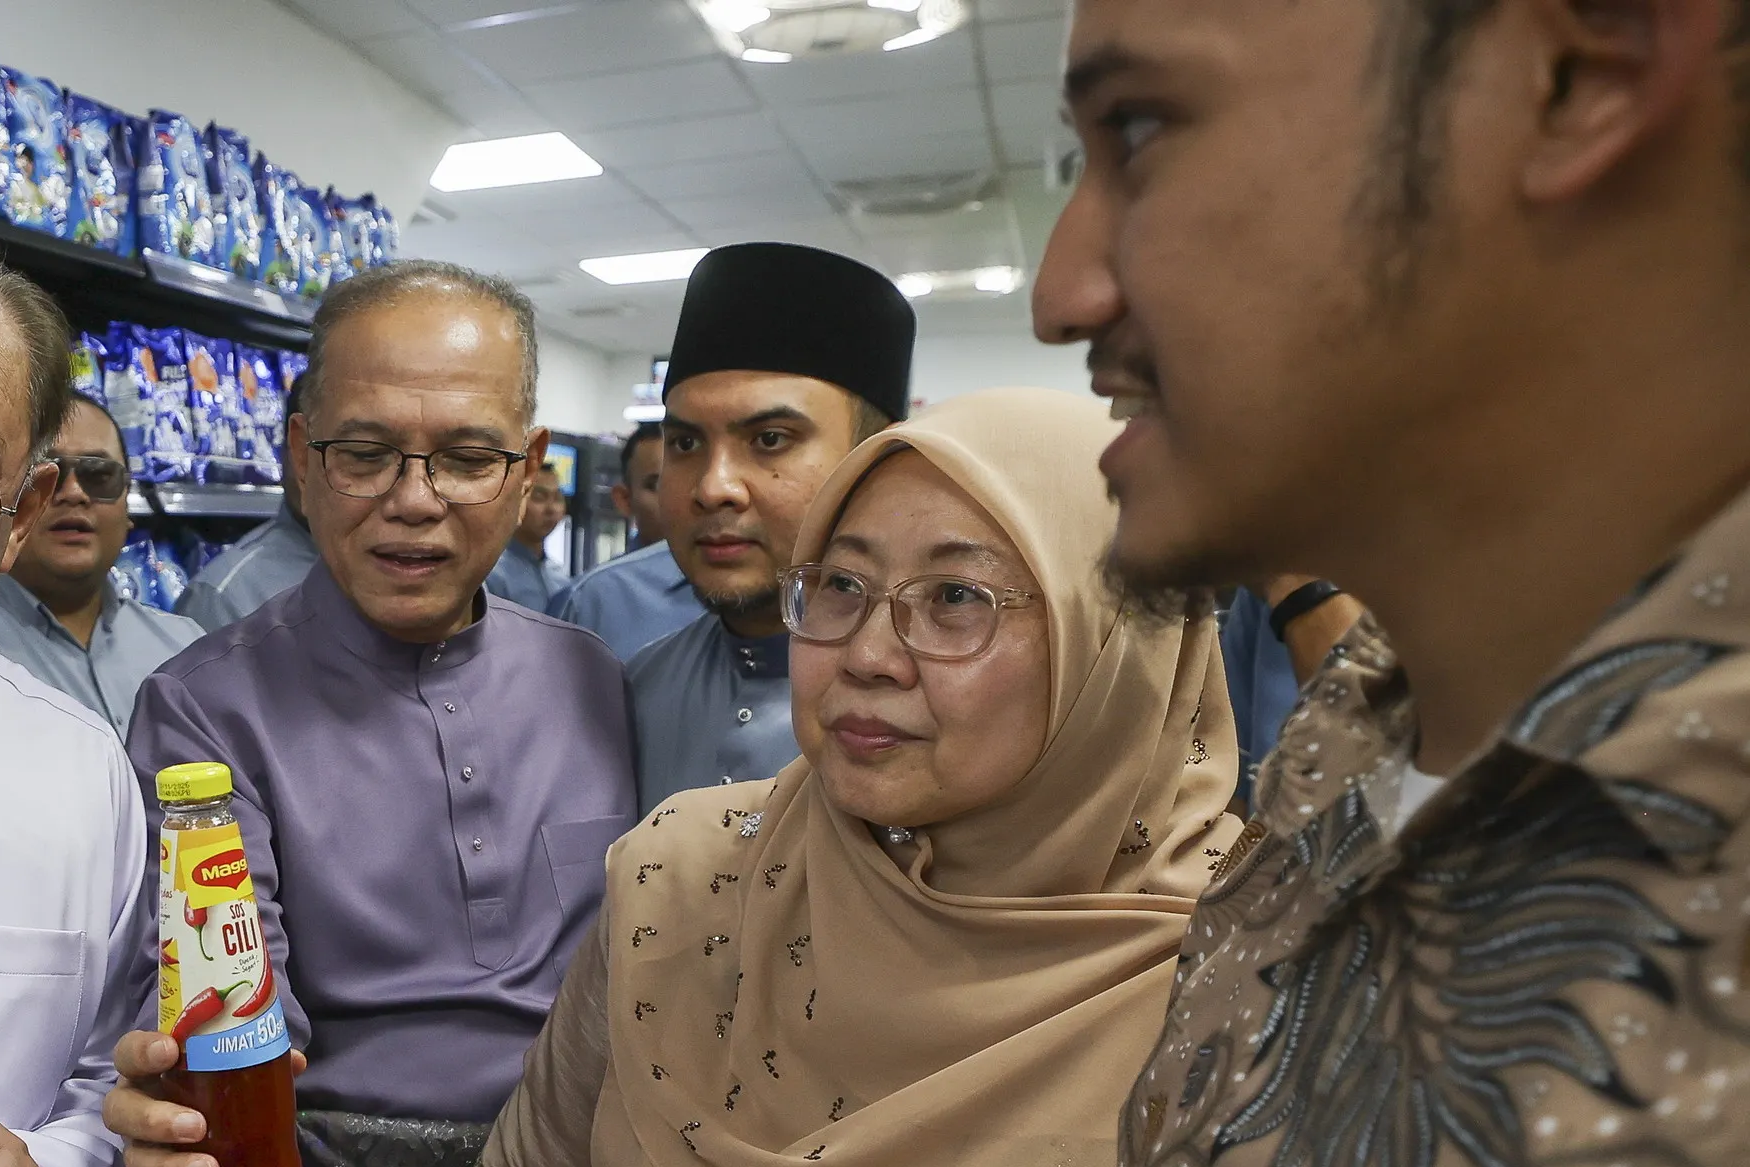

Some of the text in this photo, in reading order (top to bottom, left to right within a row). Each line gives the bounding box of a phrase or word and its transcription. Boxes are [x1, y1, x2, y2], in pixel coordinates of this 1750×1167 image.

[201, 858, 248, 881] Magg
[230, 902, 246, 920] SOS
[221, 917, 258, 957] CILI
[212, 1013, 277, 1054] JIMAT 50
